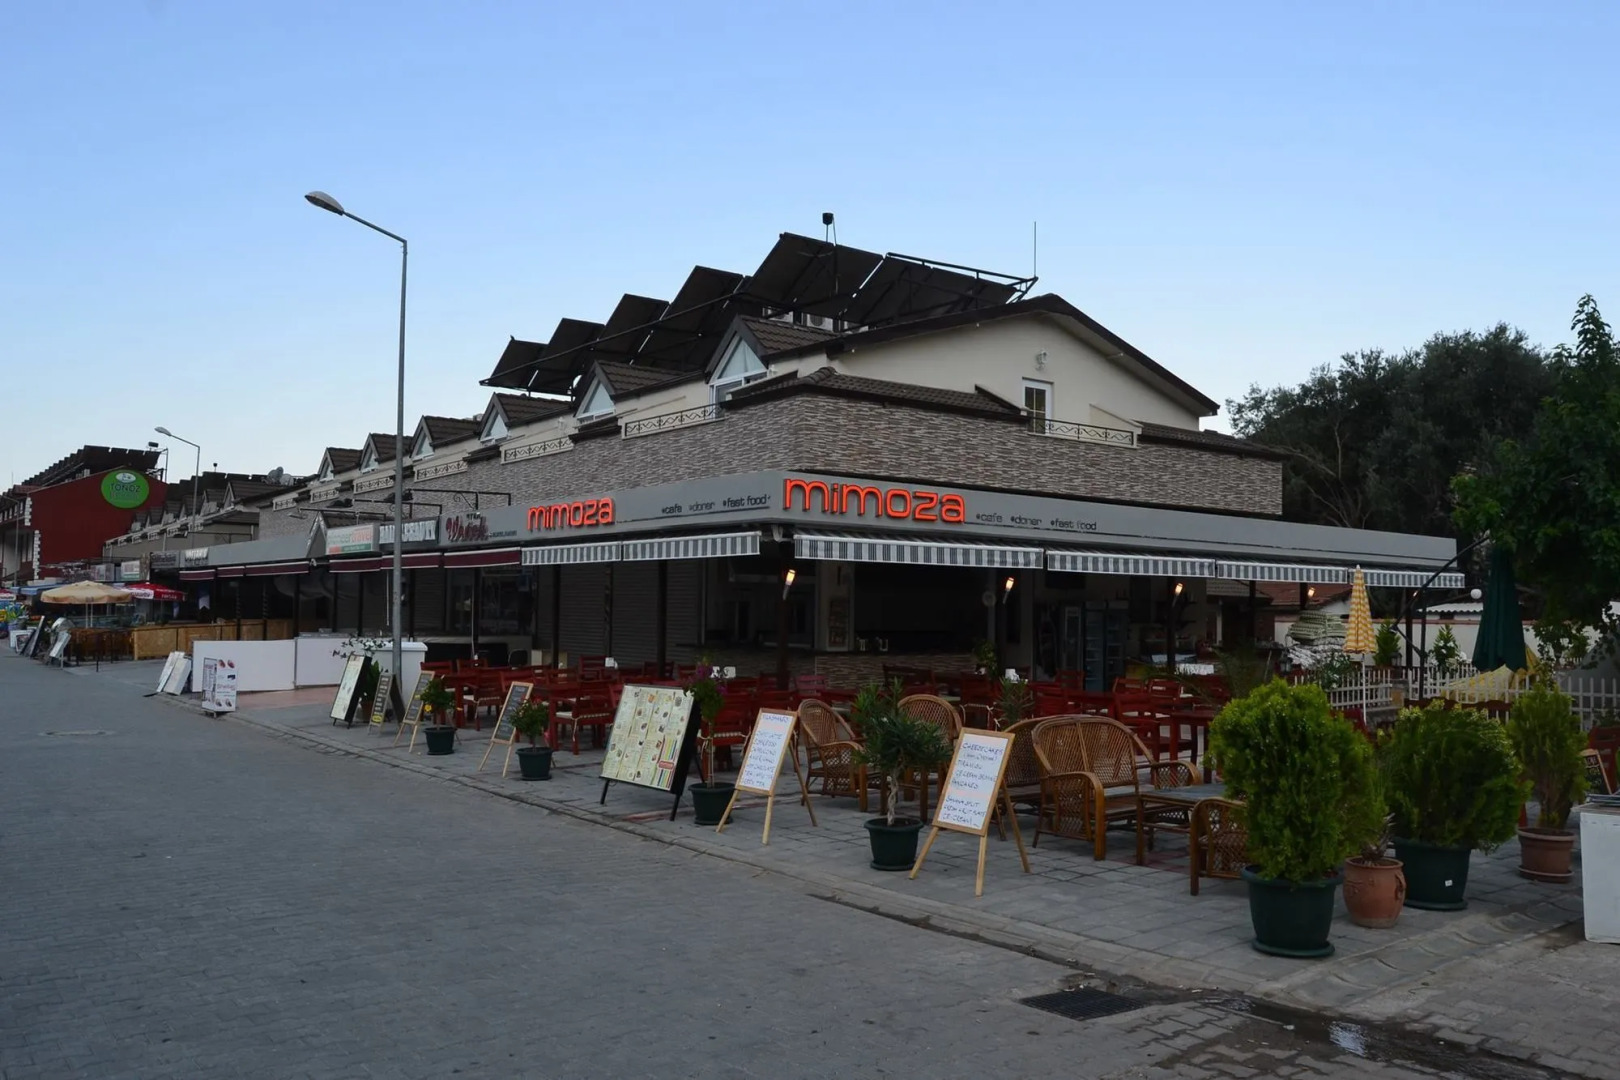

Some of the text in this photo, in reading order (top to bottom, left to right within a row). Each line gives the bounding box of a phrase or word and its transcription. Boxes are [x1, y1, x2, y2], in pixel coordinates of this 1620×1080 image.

[527, 497, 614, 531] mimoza
[665, 503, 682, 514] cafe
[727, 497, 746, 508] fast
[746, 493, 768, 506] food
[783, 478, 965, 523] mimoza
